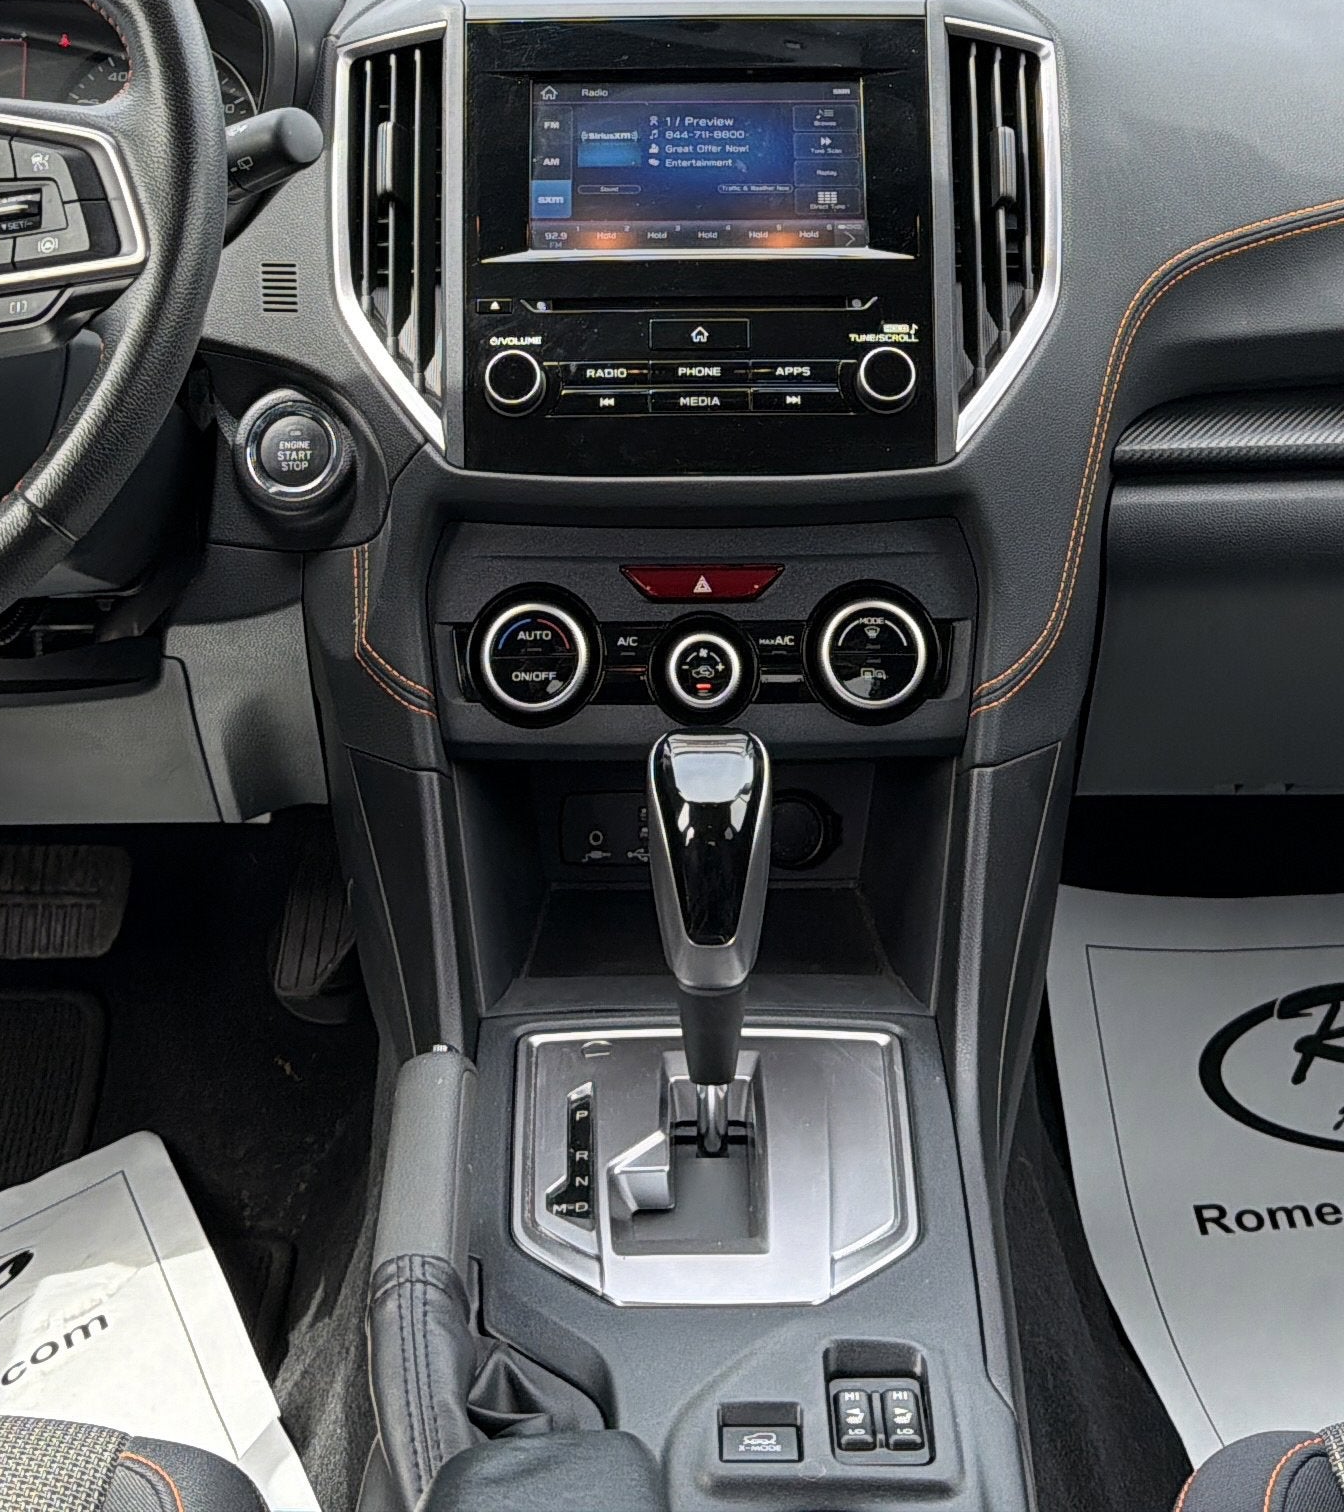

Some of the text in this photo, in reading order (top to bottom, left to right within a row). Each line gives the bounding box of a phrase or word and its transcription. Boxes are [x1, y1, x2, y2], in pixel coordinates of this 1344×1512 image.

[108, 71, 128, 82] 40
[581, 88, 608, 97] Radio
[543, 121, 560, 130] FM
[684, 116, 735, 127] Preview
[665, 144, 750, 154] Great Offer Now!
[542, 157, 560, 166] AM
[665, 158, 733, 168] Entertainment
[545, 231, 568, 240] 92.9
[596, 231, 617, 239] Hold
[647, 231, 668, 239] Hold
[698, 231, 718, 239] Hold
[748, 230, 769, 238] Hold
[798, 230, 819, 238] Hold
[848, 333, 919, 342] TUNE/SCROLL
[586, 368, 627, 378] RADIO
[677, 367, 721, 376] PHONE
[775, 366, 811, 376] APPS
[679, 396, 721, 406] MEDIA
[278, 440, 311, 450] ENGINE
[277, 450, 313, 461] START
[281, 461, 309, 471] STOP
[859, 616, 885, 625] MODE
[516, 630, 552, 641] AUTO
[616, 636, 638, 647] A/C
[511, 671, 557, 682] ON/OFF
[576, 1110, 589, 1121] P
[576, 1150, 589, 1162] R
[576, 1175, 589, 1187] N
[844, 1390, 860, 1401] HI
[892, 1390, 908, 1401] HI
[738, 1443, 783, 1452] X-MODE
